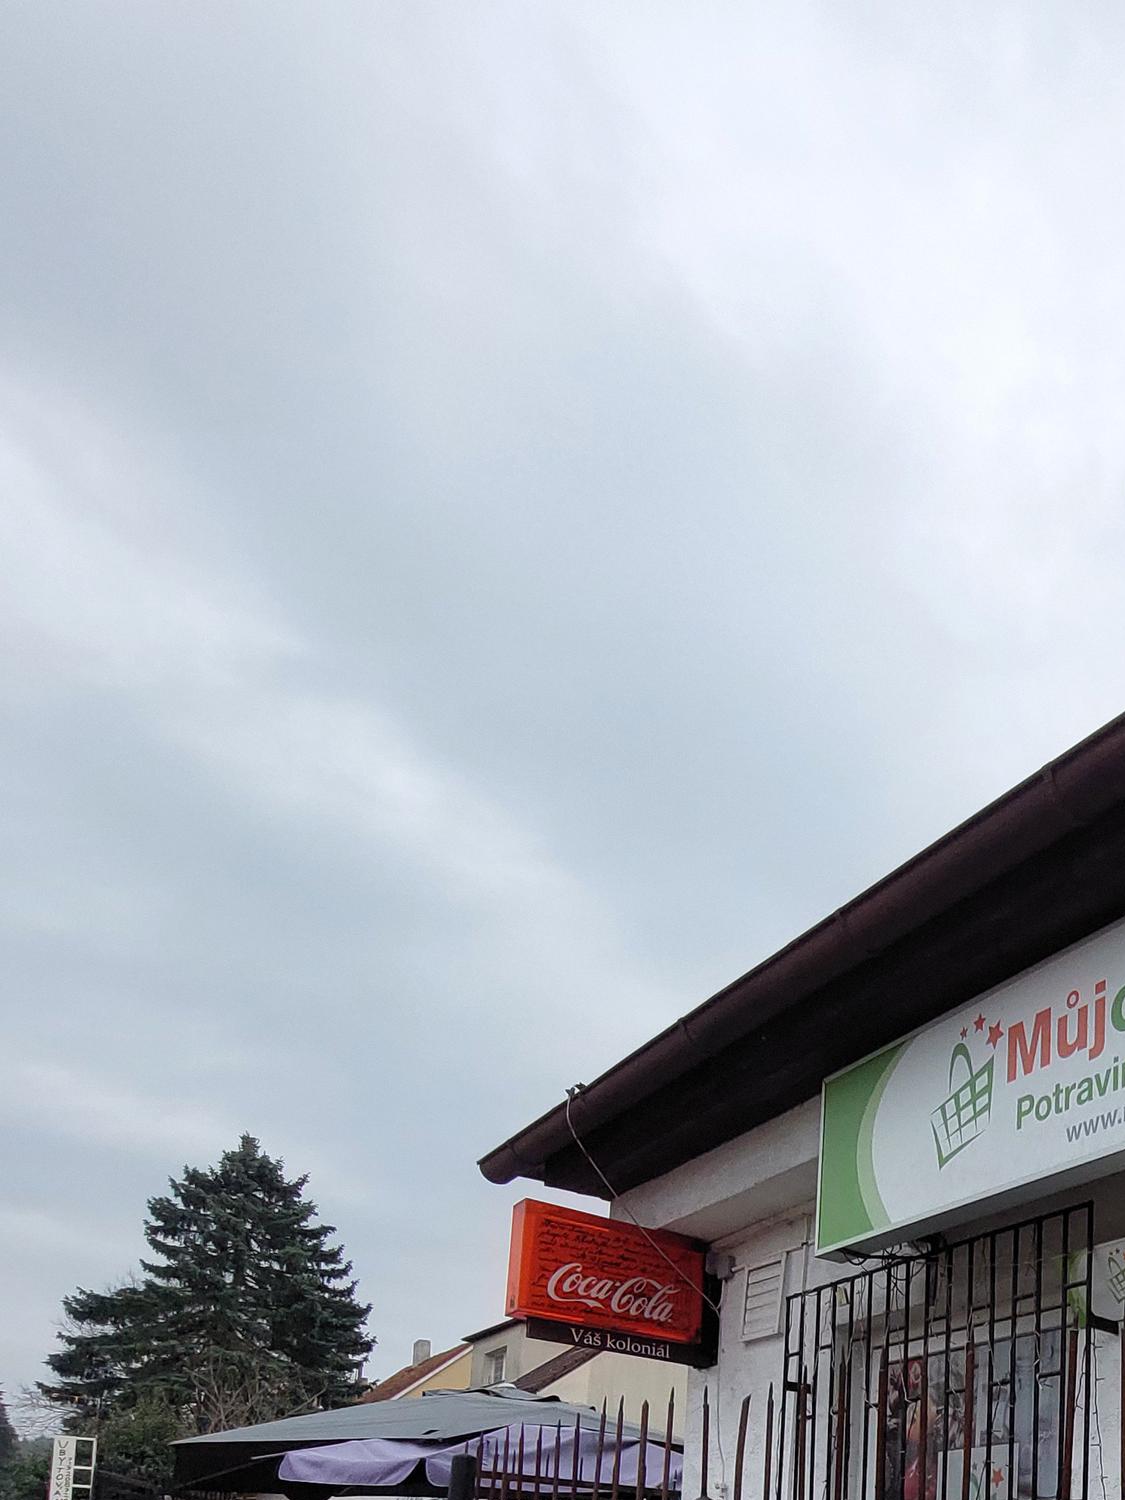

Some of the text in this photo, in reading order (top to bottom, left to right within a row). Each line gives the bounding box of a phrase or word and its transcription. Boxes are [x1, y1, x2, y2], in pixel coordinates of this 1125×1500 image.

[547, 1262, 681, 1323] Coca-Cola
[570, 1327, 671, 1359] Váš koloniál
